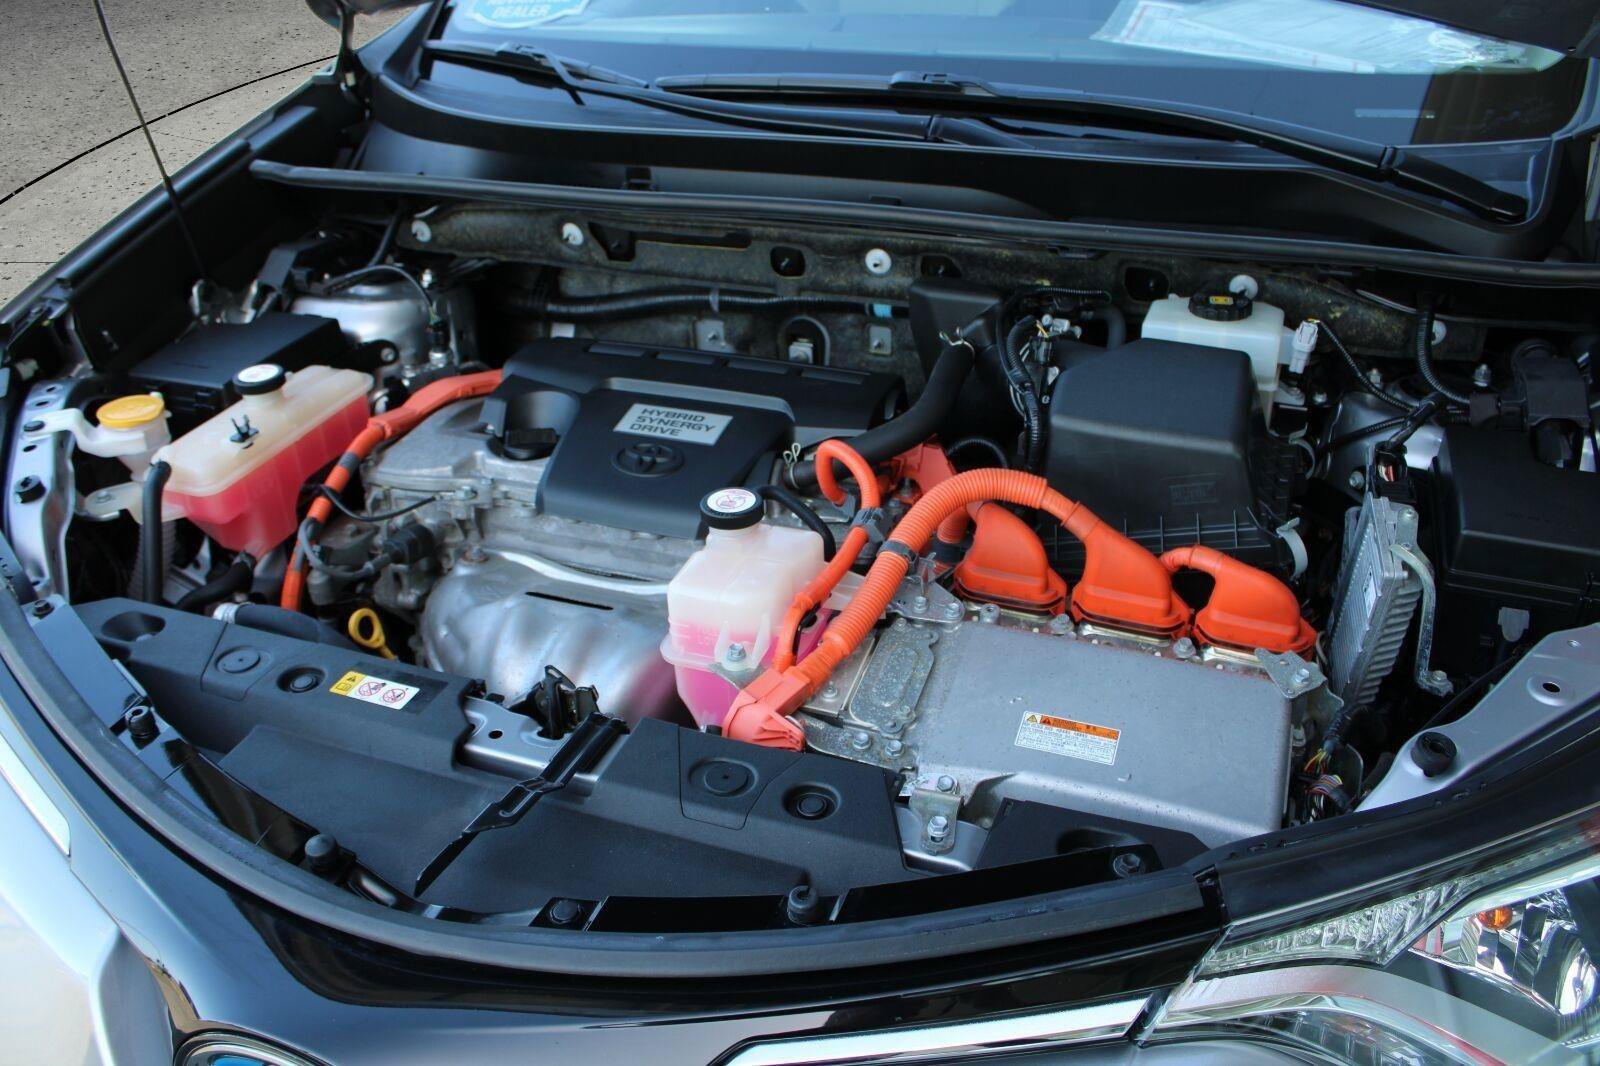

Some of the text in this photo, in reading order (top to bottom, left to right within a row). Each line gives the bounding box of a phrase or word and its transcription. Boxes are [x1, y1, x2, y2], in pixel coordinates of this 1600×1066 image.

[493, 5, 549, 18] DEALER
[641, 408, 706, 422] HYBRID
[630, 423, 683, 436] DRIVE
[636, 415, 716, 432] SYNERGY
